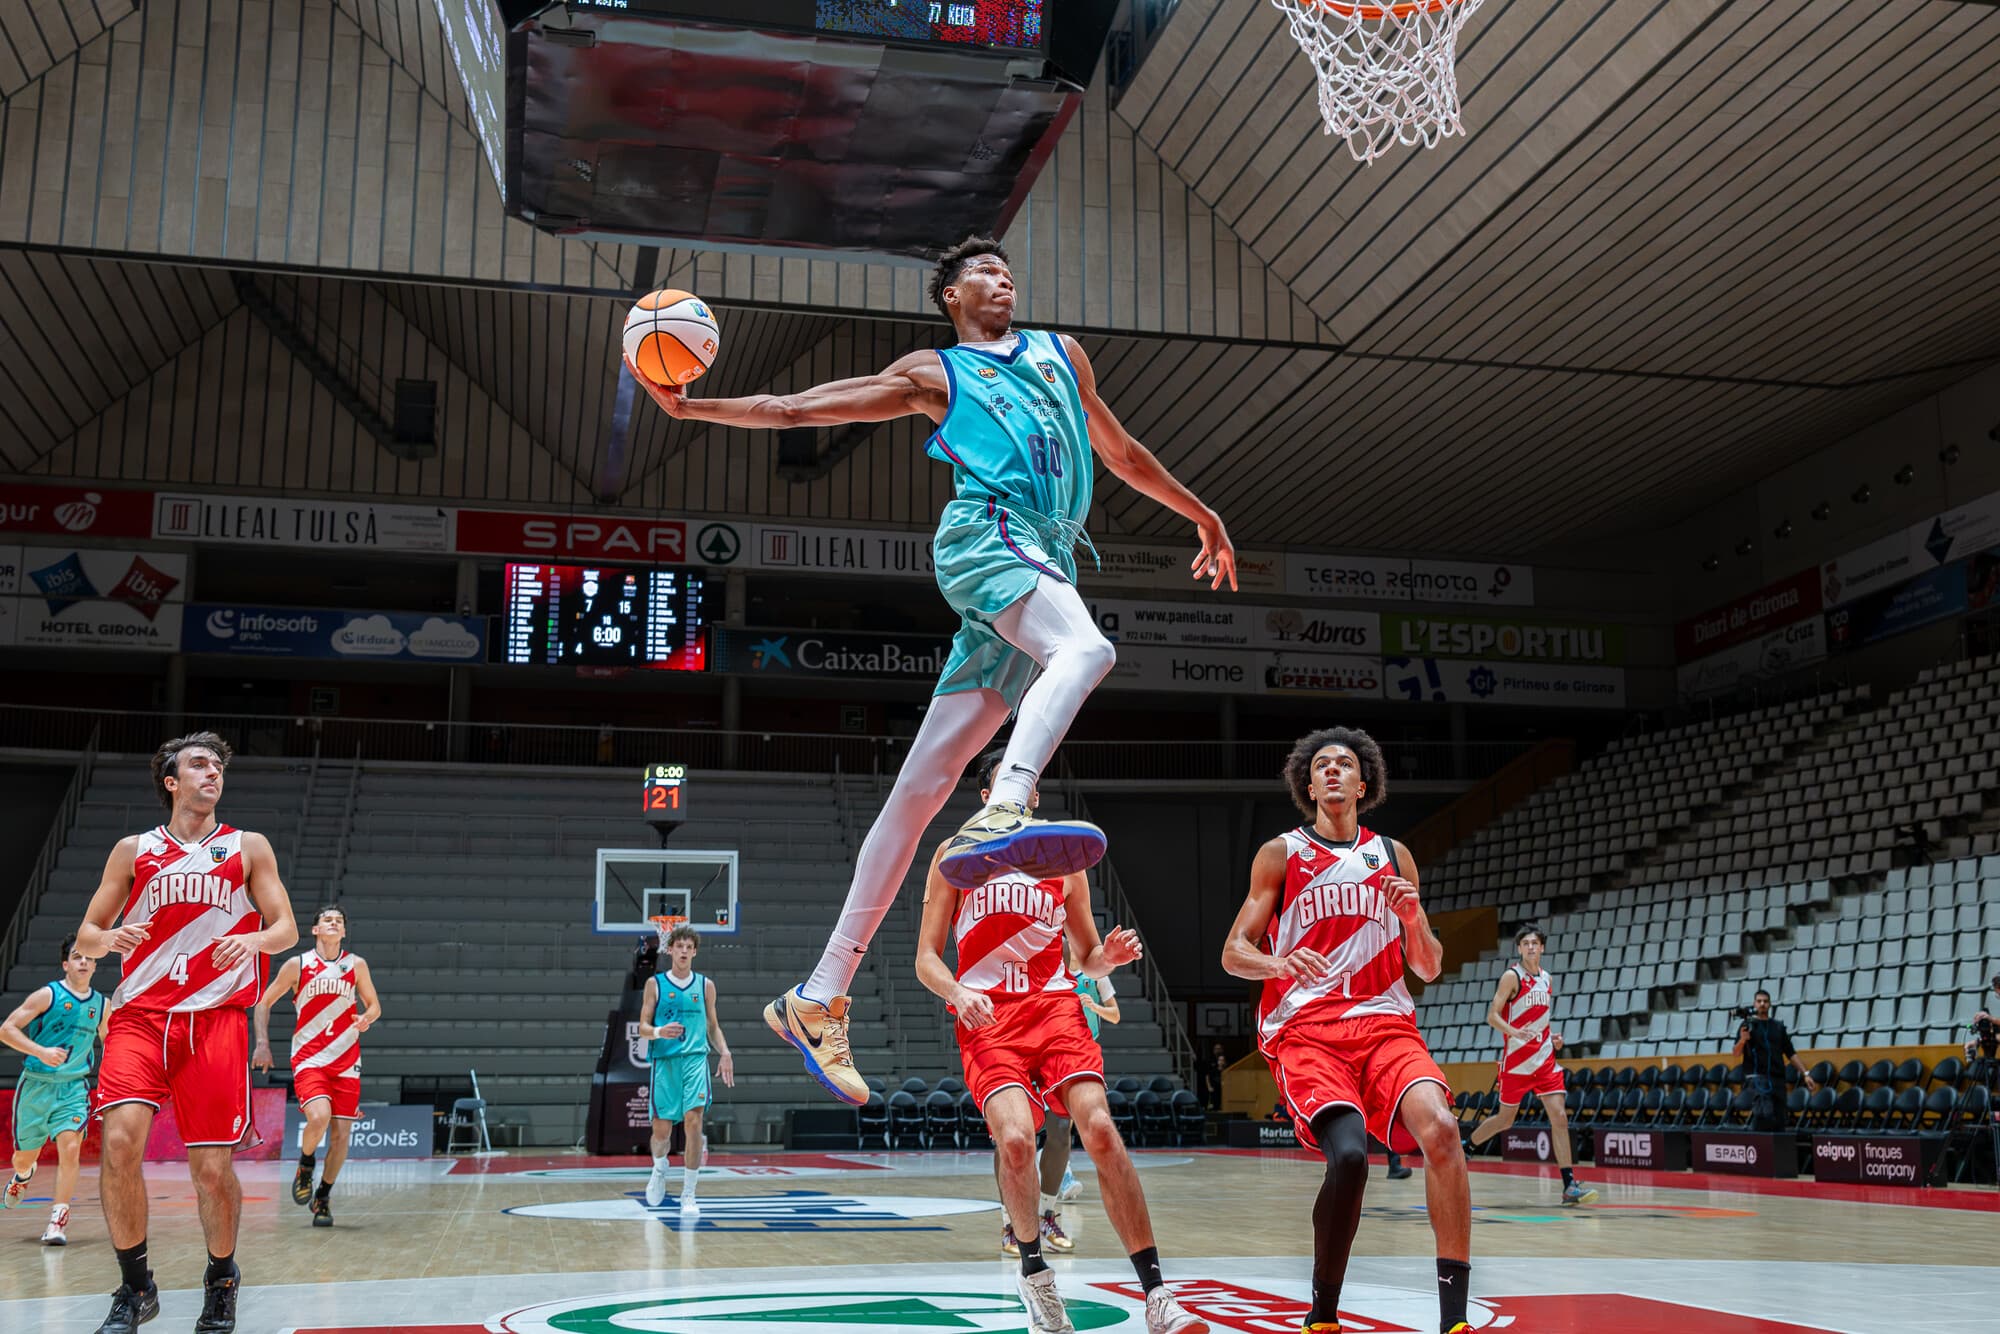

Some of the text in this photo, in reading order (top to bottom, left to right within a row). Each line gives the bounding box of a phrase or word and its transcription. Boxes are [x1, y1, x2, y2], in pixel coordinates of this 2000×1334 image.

[205, 504, 280, 540] LLEAL
[292, 507, 378, 545] TULSÀ
[522, 521, 683, 555] SPAR
[802, 535, 935, 572] LLEAL TULS
[1129, 552, 1177, 569] village
[45, 567, 75, 588] ibis
[125, 570, 162, 602] ibis
[585, 599, 631, 614] 7 15
[1135, 609, 1233, 625] www.panella.cat
[1695, 611, 1727, 643] Diari
[1730, 608, 1746, 629] de
[1750, 587, 1799, 620] Girona
[41, 620, 159, 637] HOTEL GIRONA
[239, 612, 318, 634] infosoft
[1298, 620, 1367, 646] Abras
[593, 626, 621, 643] 6:00
[575, 643, 582, 655] 4
[630, 645, 636, 657] 1
[1172, 659, 1243, 682] Home
[1503, 677, 1615, 694] Pirineu de Girona
[655, 766, 684, 778] 6:00
[651, 786, 679, 809] 21
[147, 872, 232, 915] GIRONA
[972, 882, 1054, 928] GIRONA
[1296, 882, 1386, 930] GIRONA
[168, 953, 189, 986] 4
[1002, 960, 1030, 993] 16
[307, 978, 351, 1000] GIRONA
[1340, 970, 1352, 999] 1
[325, 1019, 335, 1036] 2
[349, 1129, 418, 1147] IRONÈS
[1259, 1127, 1295, 1137] Marlex
[1604, 1132, 1652, 1157] FMG
[1715, 1147, 1744, 1159] SPAR
[1817, 1141, 1903, 1161] ceigrup finques
[1866, 1163, 1916, 1181] company
